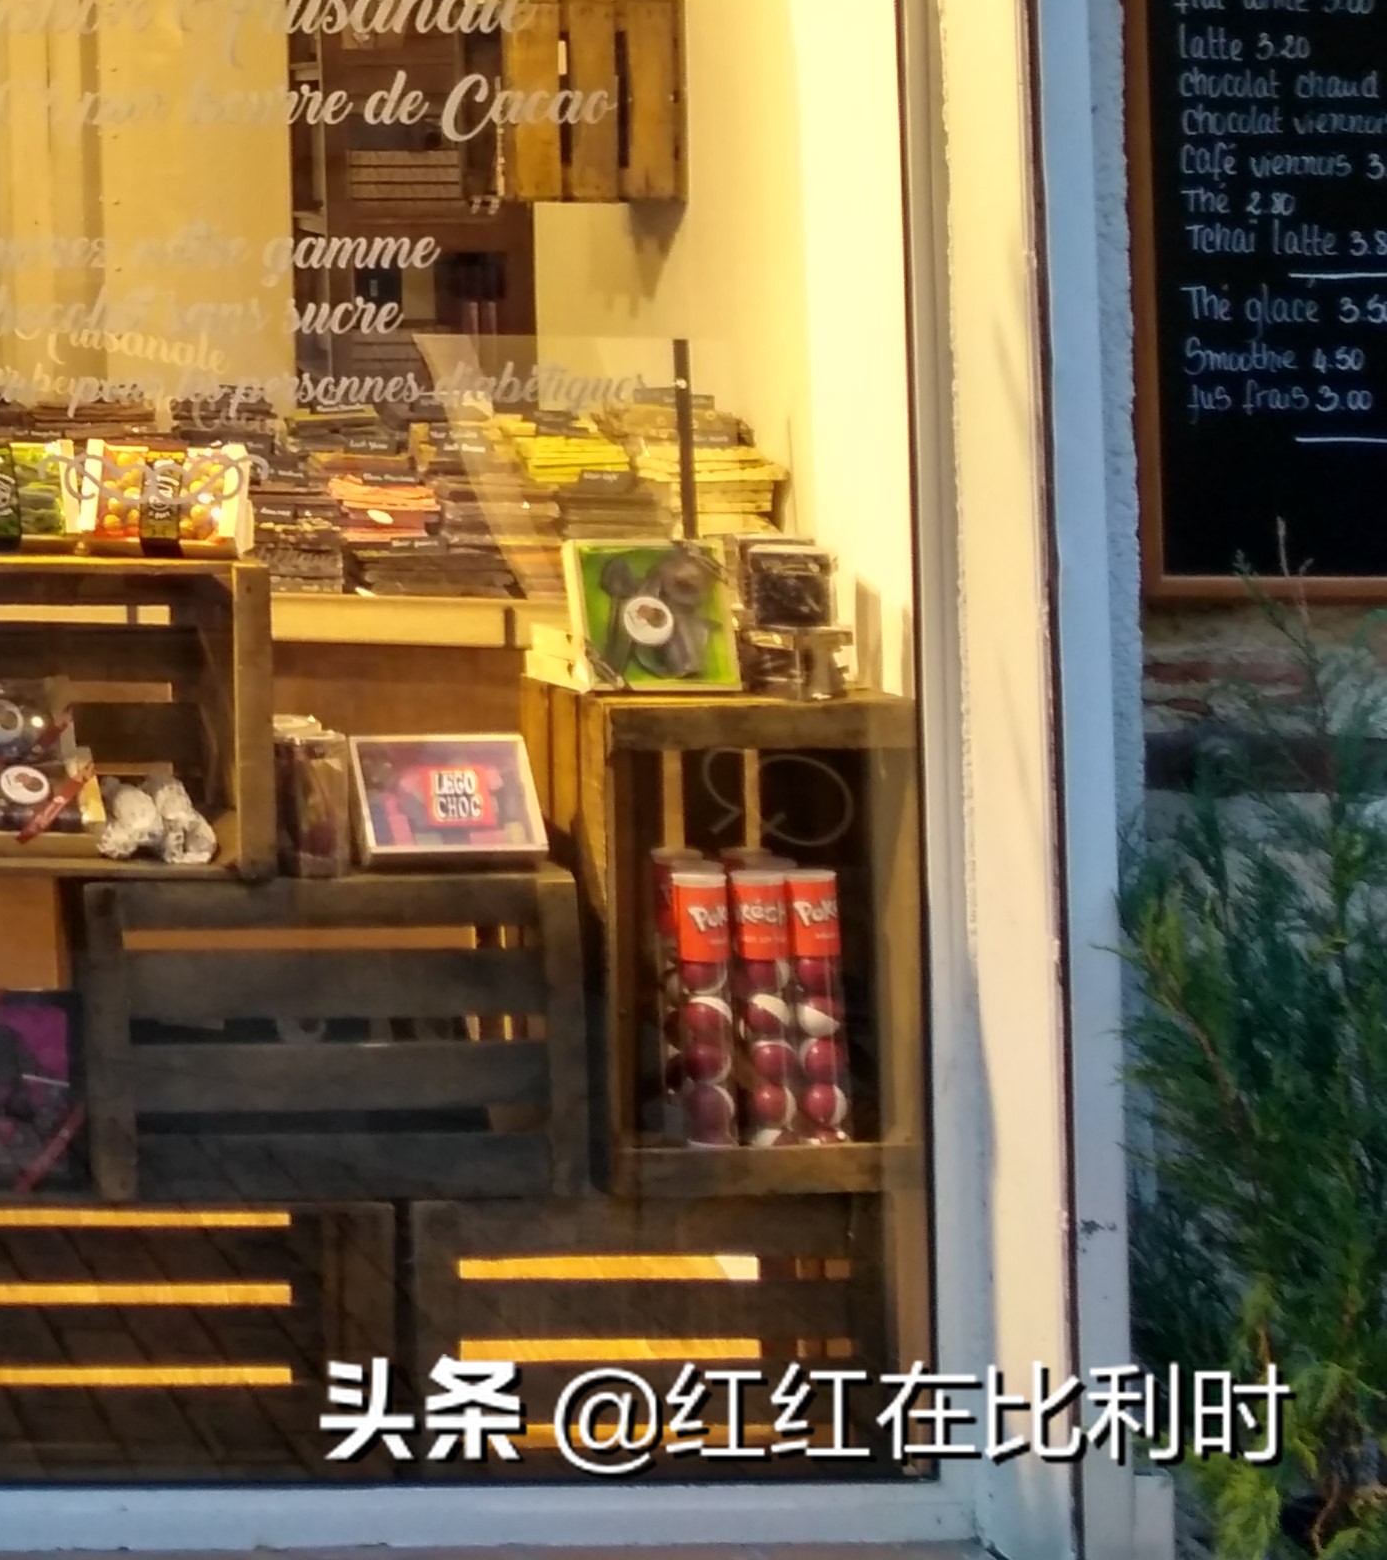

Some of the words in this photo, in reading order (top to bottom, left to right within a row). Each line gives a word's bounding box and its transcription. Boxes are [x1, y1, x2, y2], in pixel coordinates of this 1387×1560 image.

[1179, 23, 1244, 61] latte
[1255, 31, 1311, 61] 3.20
[1179, 67, 1282, 99] chocolat
[1296, 69, 1379, 99] chaud
[364, 71, 430, 127] de
[442, 74, 619, 142] Cacao
[1183, 103, 1284, 136] chocolat
[1180, 142, 1238, 181] Café
[1181, 183, 1229, 214] Thé
[1245, 190, 1296, 216] 2.80
[1272, 218, 1339, 256] latte
[263, 235, 441, 287] gamme
[288, 294, 405, 335] sucre
[1180, 284, 1232, 322] Thé
[1184, 335, 1300, 376] Smoothie
[1313, 346, 1365, 374] 4.50
[227, 370, 423, 417] personnes
[1242, 380, 1310, 416] frais
[1316, 385, 1375, 413] 3.00
[433, 770, 477, 794] LEGO
[435, 794, 482, 820] CHOC
